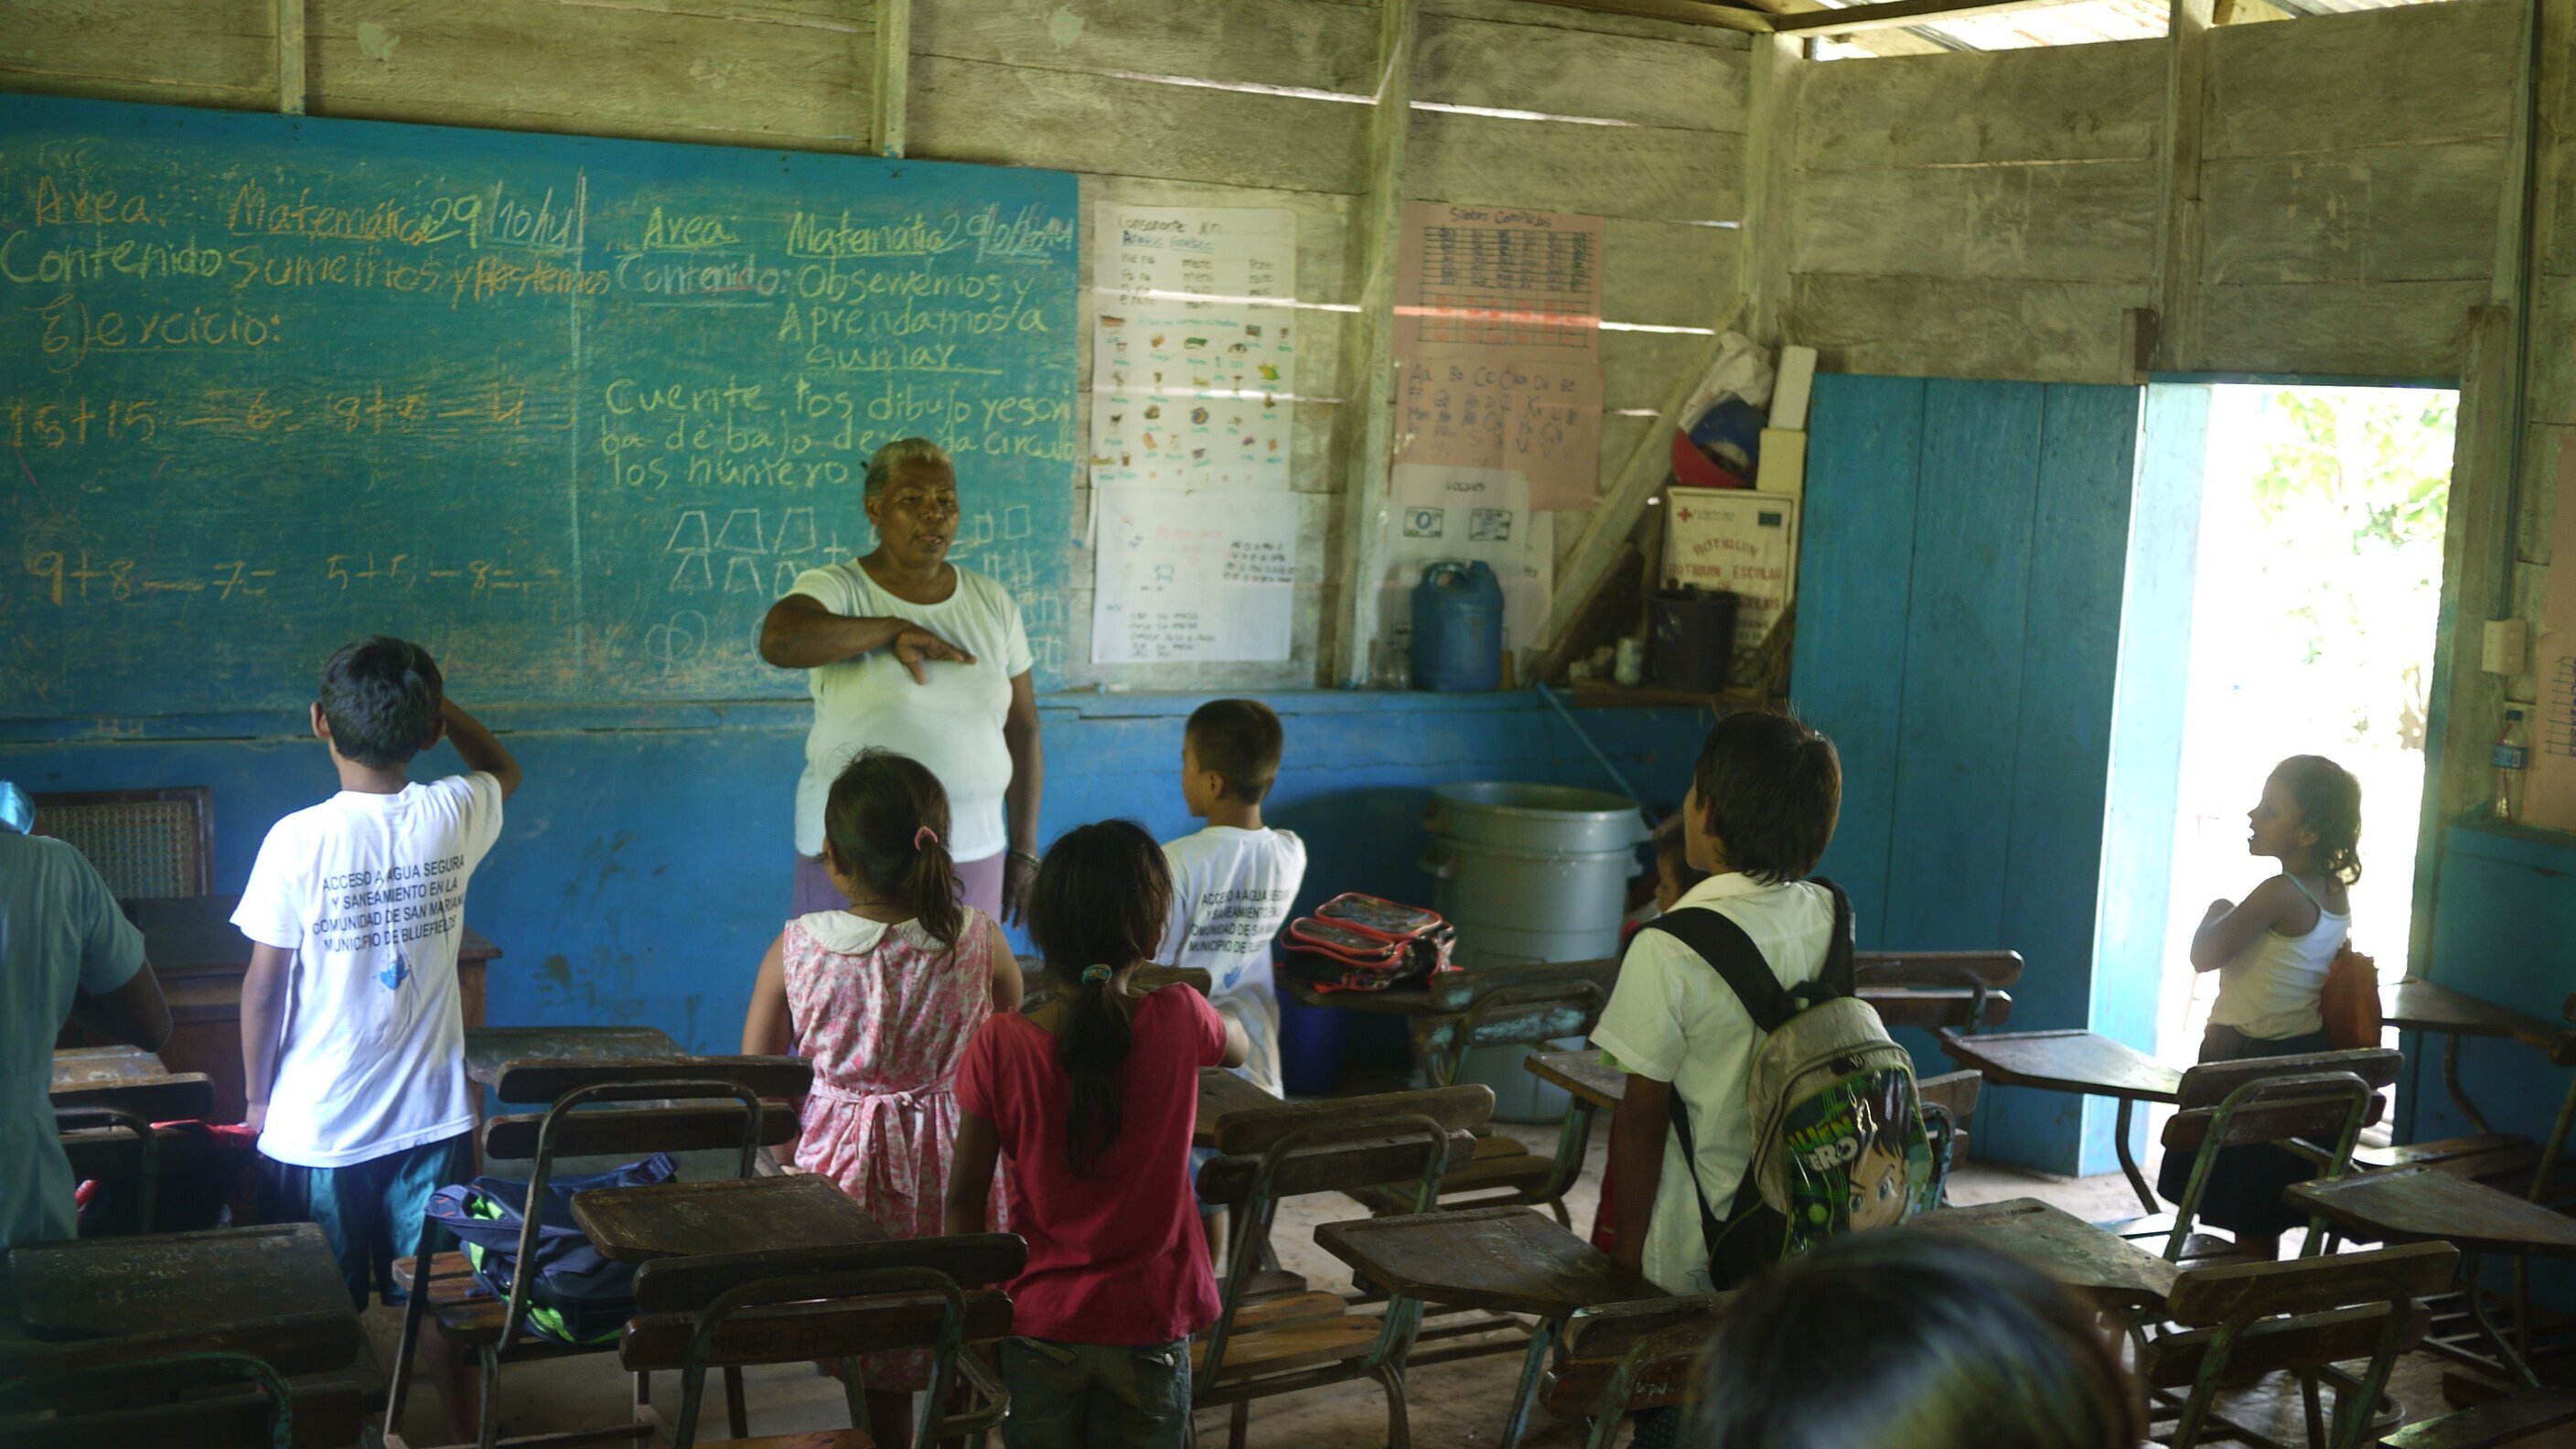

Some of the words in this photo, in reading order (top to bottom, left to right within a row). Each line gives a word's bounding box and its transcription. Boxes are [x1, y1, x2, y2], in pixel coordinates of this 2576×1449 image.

[323, 871, 372, 893] ACCESO
[375, 871, 384, 885] A
[386, 864, 421, 883] AGUA
[424, 854, 466, 877] SEGURA
[331, 897, 339, 911] Y
[343, 883, 428, 910] SANEAMIENTO
[429, 881, 444, 897] EN
[445, 876, 458, 893] LA
[313, 911, 382, 935] COMUNIDAD
[385, 907, 401, 925] DE
[403, 902, 428, 921] SAN
[384, 929, 400, 946] DE
[402, 914, 458, 943] BLUEFIELDS
